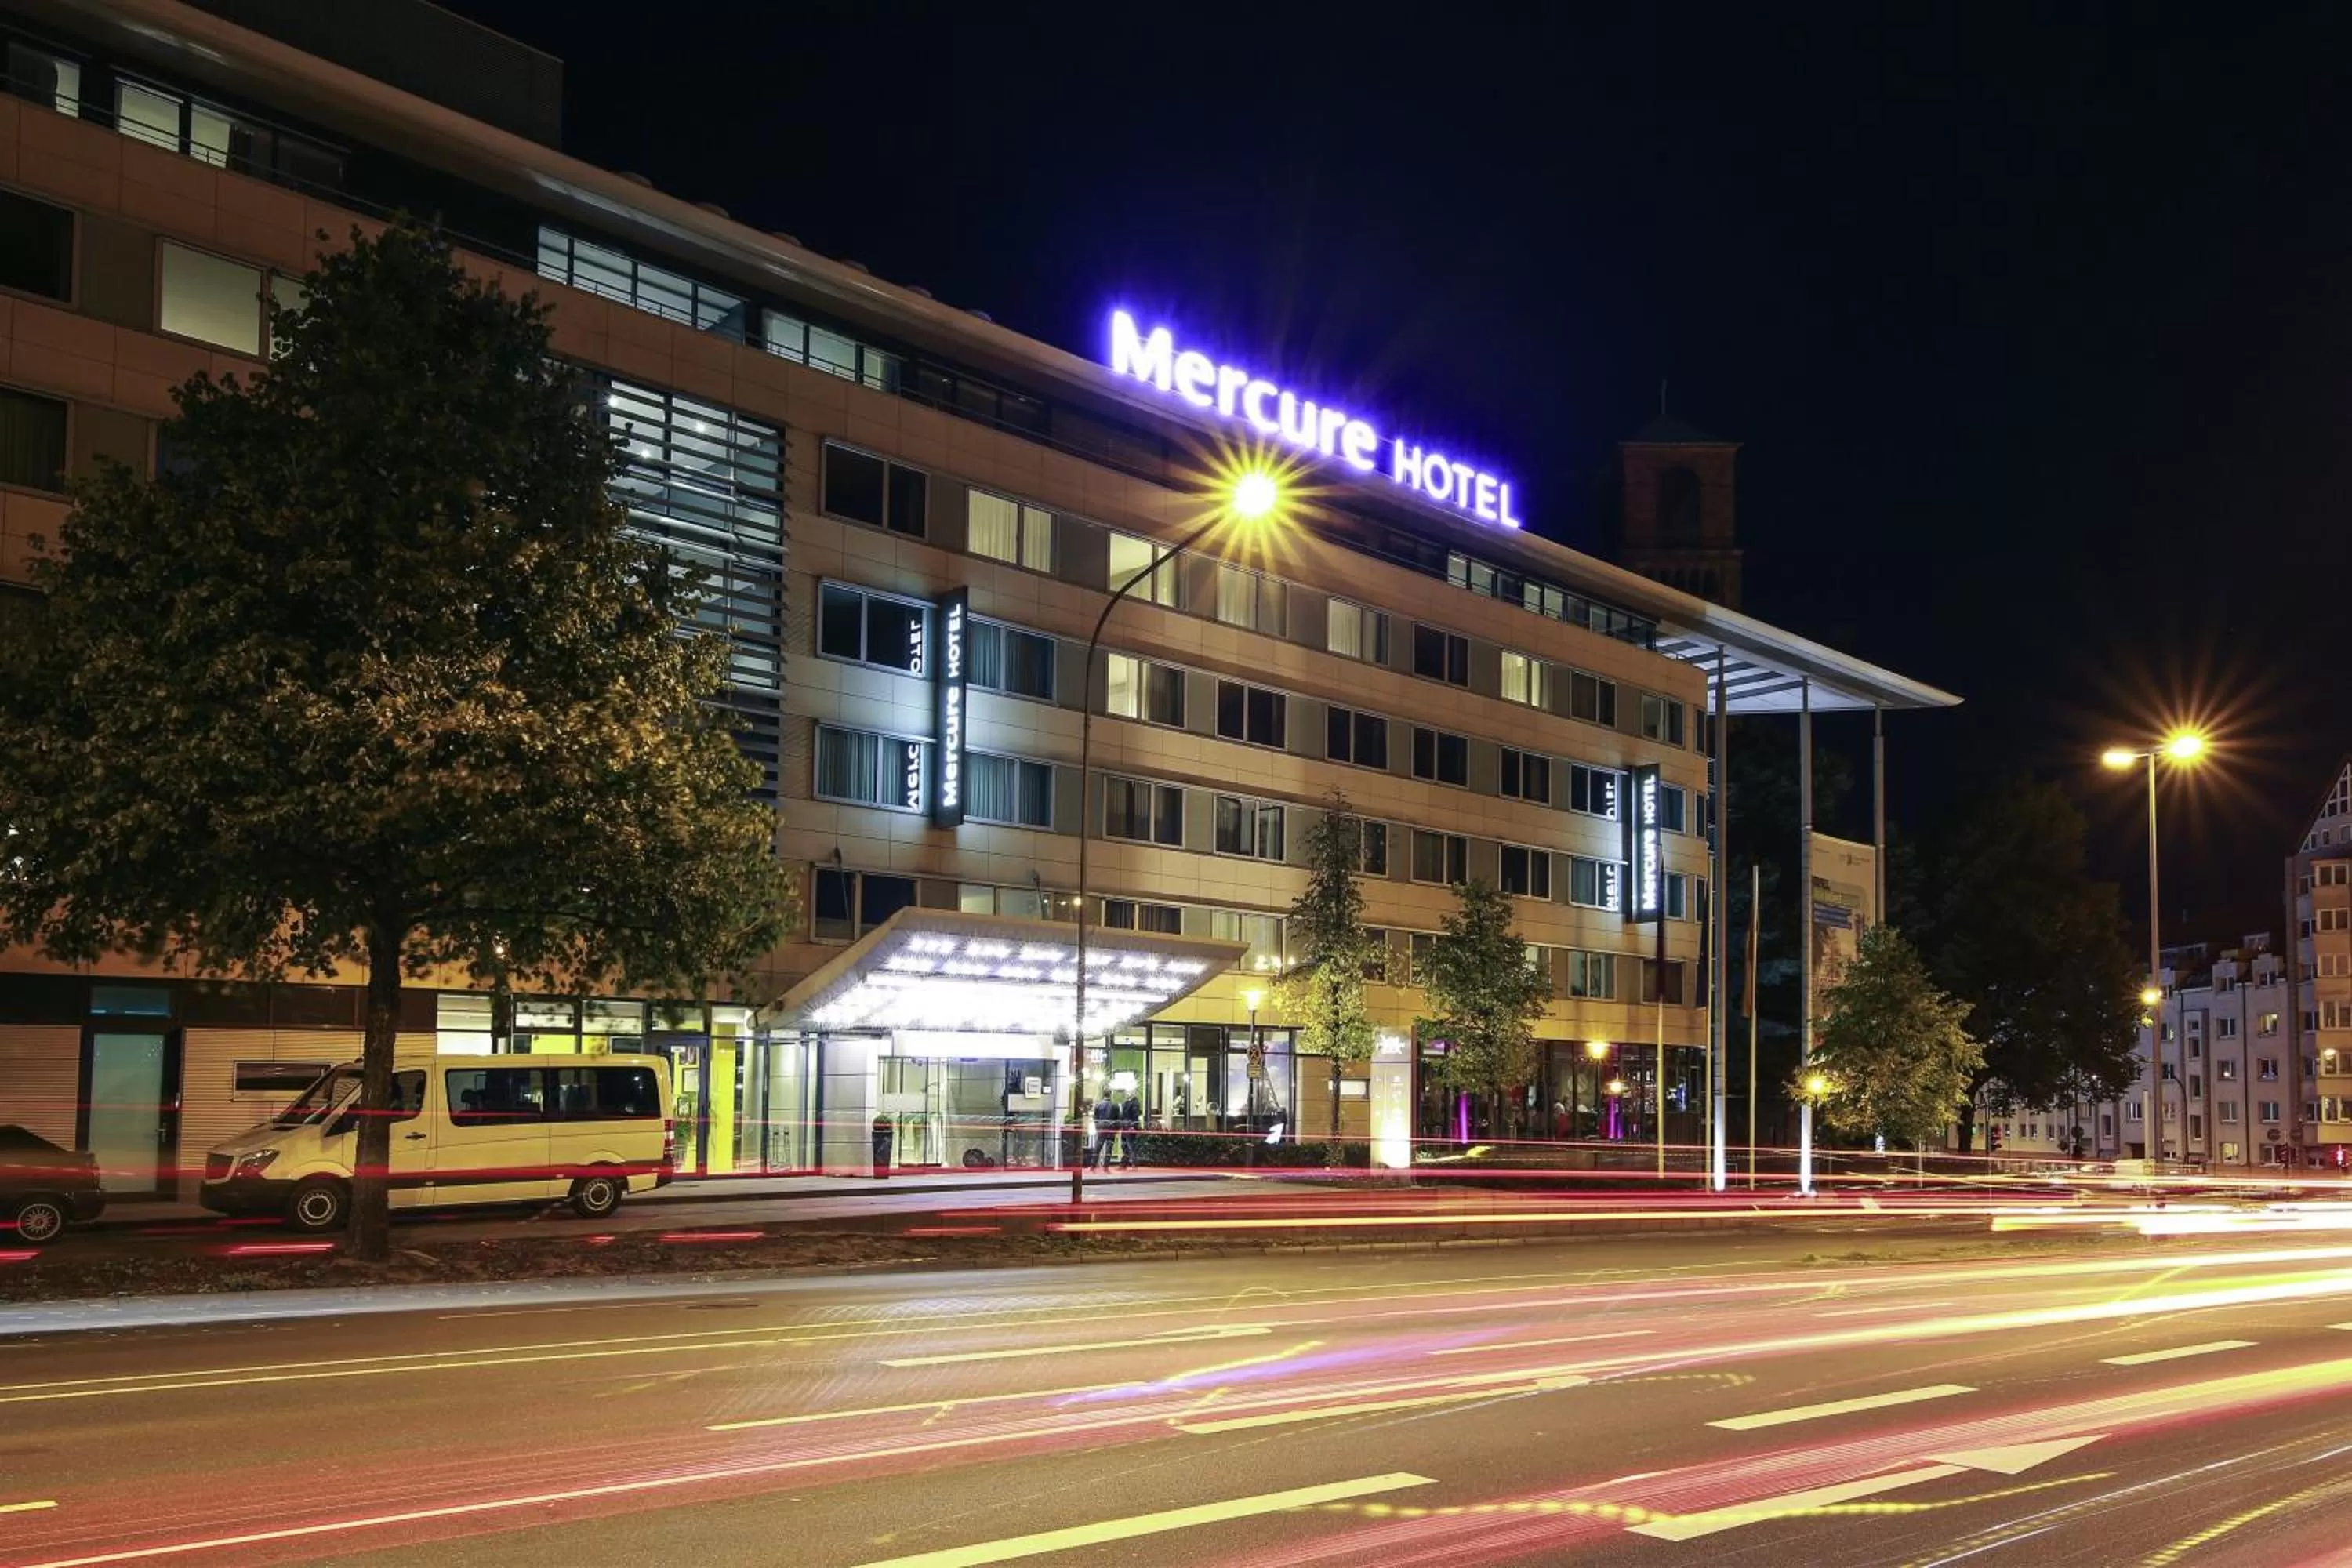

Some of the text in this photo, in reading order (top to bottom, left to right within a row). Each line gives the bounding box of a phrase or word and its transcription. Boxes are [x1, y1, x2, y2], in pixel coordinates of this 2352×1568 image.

[1112, 311, 1520, 528] Mercure HOTEL
[943, 603, 960, 807] Mercure HOTEL
[1643, 773, 1656, 824] HOTEL
